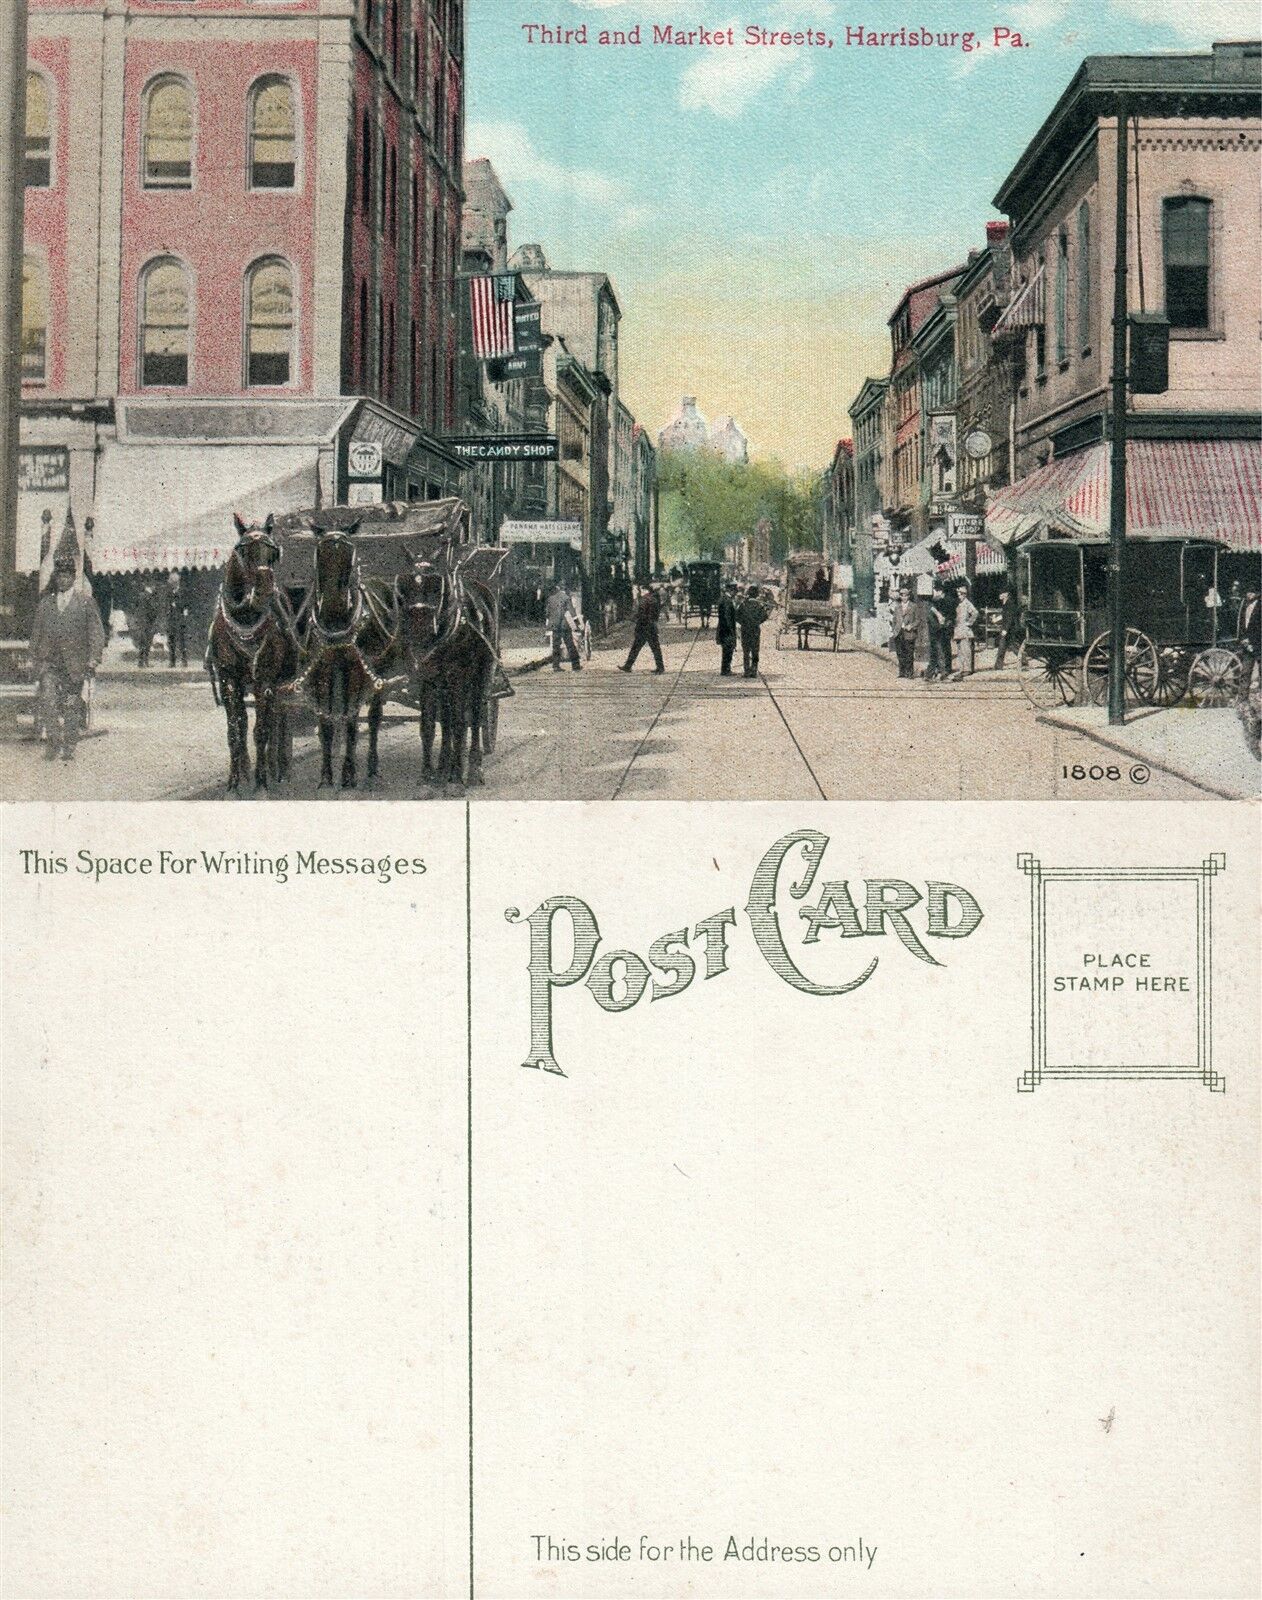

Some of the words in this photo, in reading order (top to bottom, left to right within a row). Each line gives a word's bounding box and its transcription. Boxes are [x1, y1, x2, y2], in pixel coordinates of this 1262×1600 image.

[523, 444, 554, 456] SHOP
[20, 850, 68, 875] This
[75, 849, 153, 881] Space
[159, 850, 197, 875] For
[200, 850, 289, 883] Writing
[295, 850, 427, 884] Messages
[1083, 953, 1151, 968] PLACE
[1053, 977, 1125, 992] STAMP
[1136, 977, 1191, 992] HERE
[530, 1535, 581, 1562] This
[586, 1537, 632, 1562] side
[639, 1536, 673, 1562] for
[680, 1537, 714, 1562] the
[723, 1535, 821, 1562] Address
[828, 1537, 878, 1570] only
